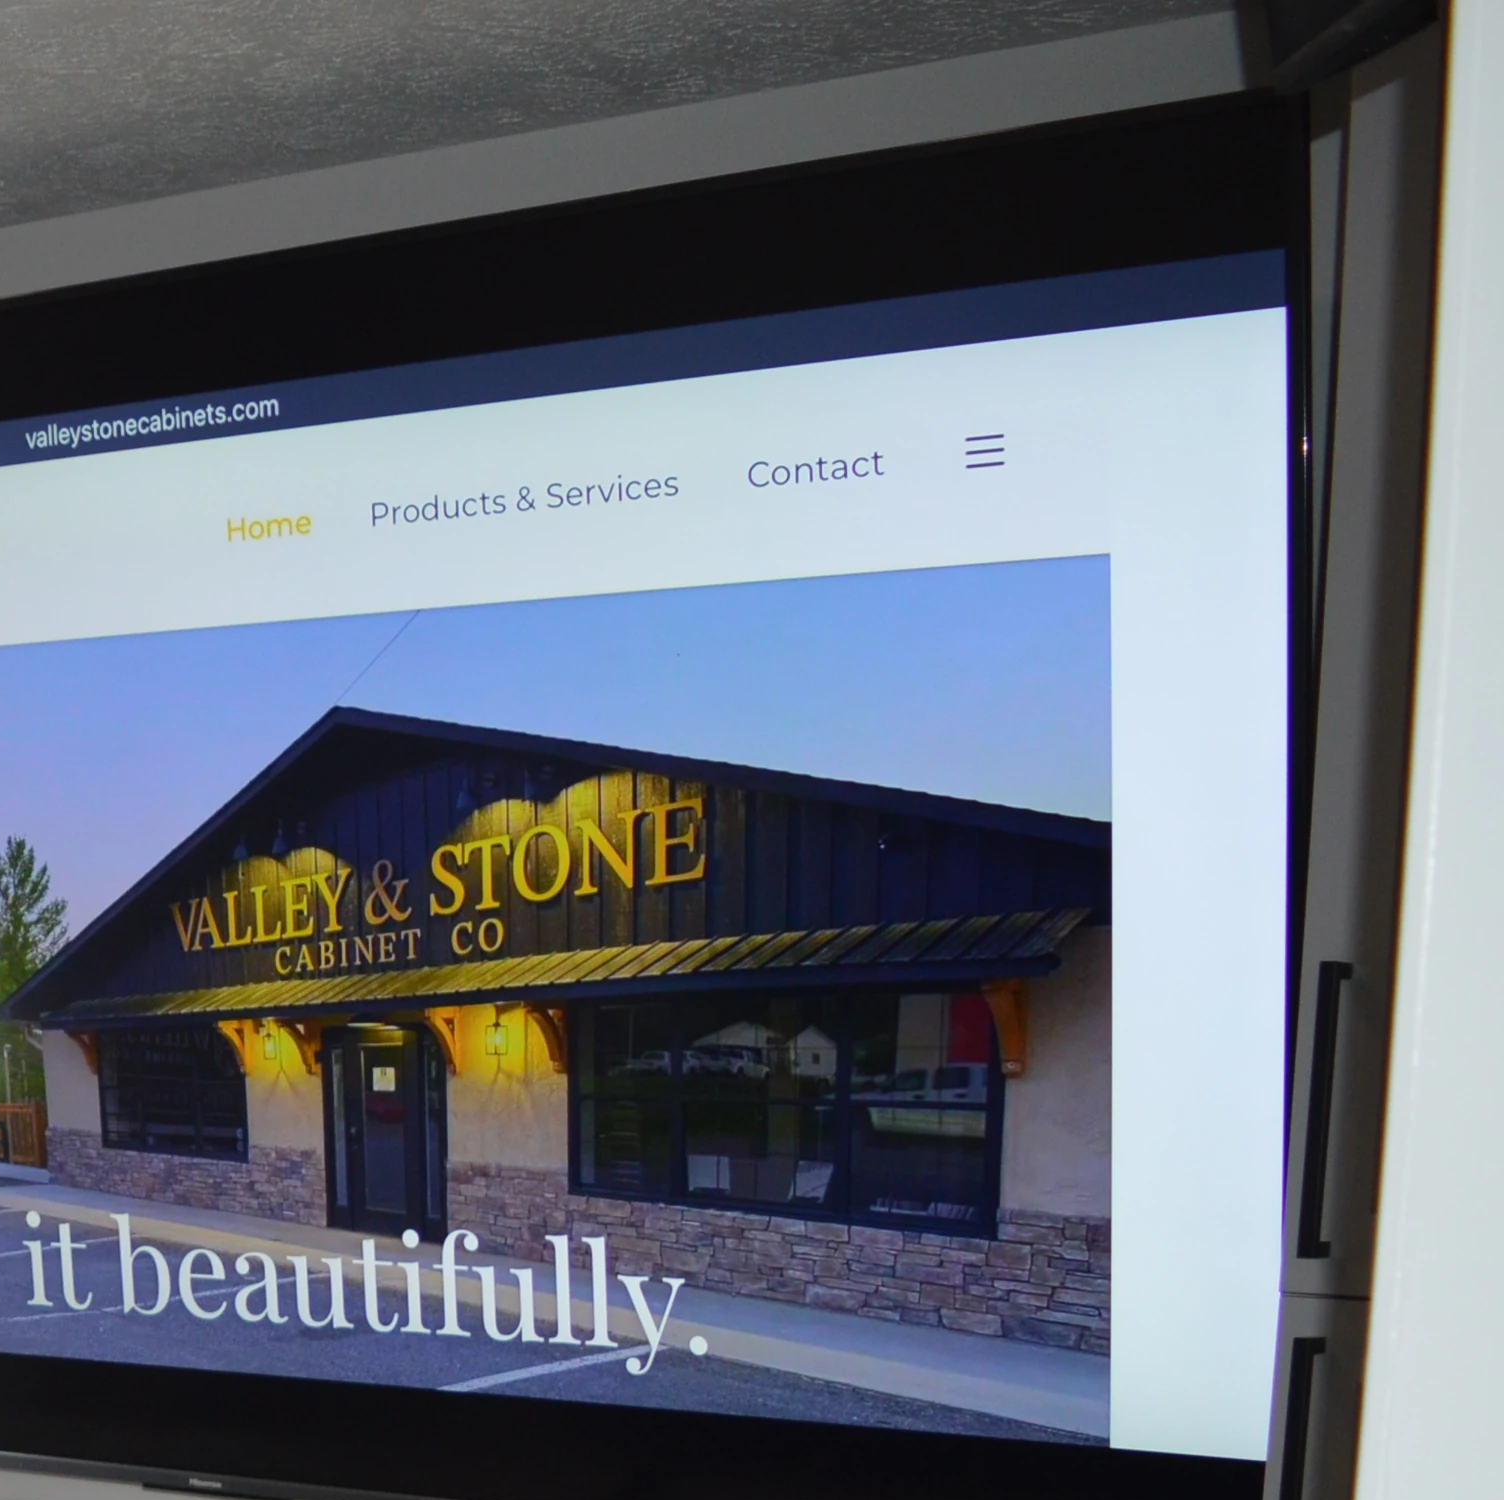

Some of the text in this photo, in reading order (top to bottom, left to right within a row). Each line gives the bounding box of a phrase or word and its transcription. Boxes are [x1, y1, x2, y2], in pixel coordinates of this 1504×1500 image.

[25, 398, 280, 449] valleystonecabinets.com
[747, 450, 885, 488] Contact
[226, 515, 312, 541] Home
[370, 474, 680, 528] Products & Services
[170, 799, 706, 953] VALLEY & STONE
[275, 919, 505, 976] CABINET CO
[22, 1210, 92, 1310] it
[110, 1213, 708, 1376] beautifully.
